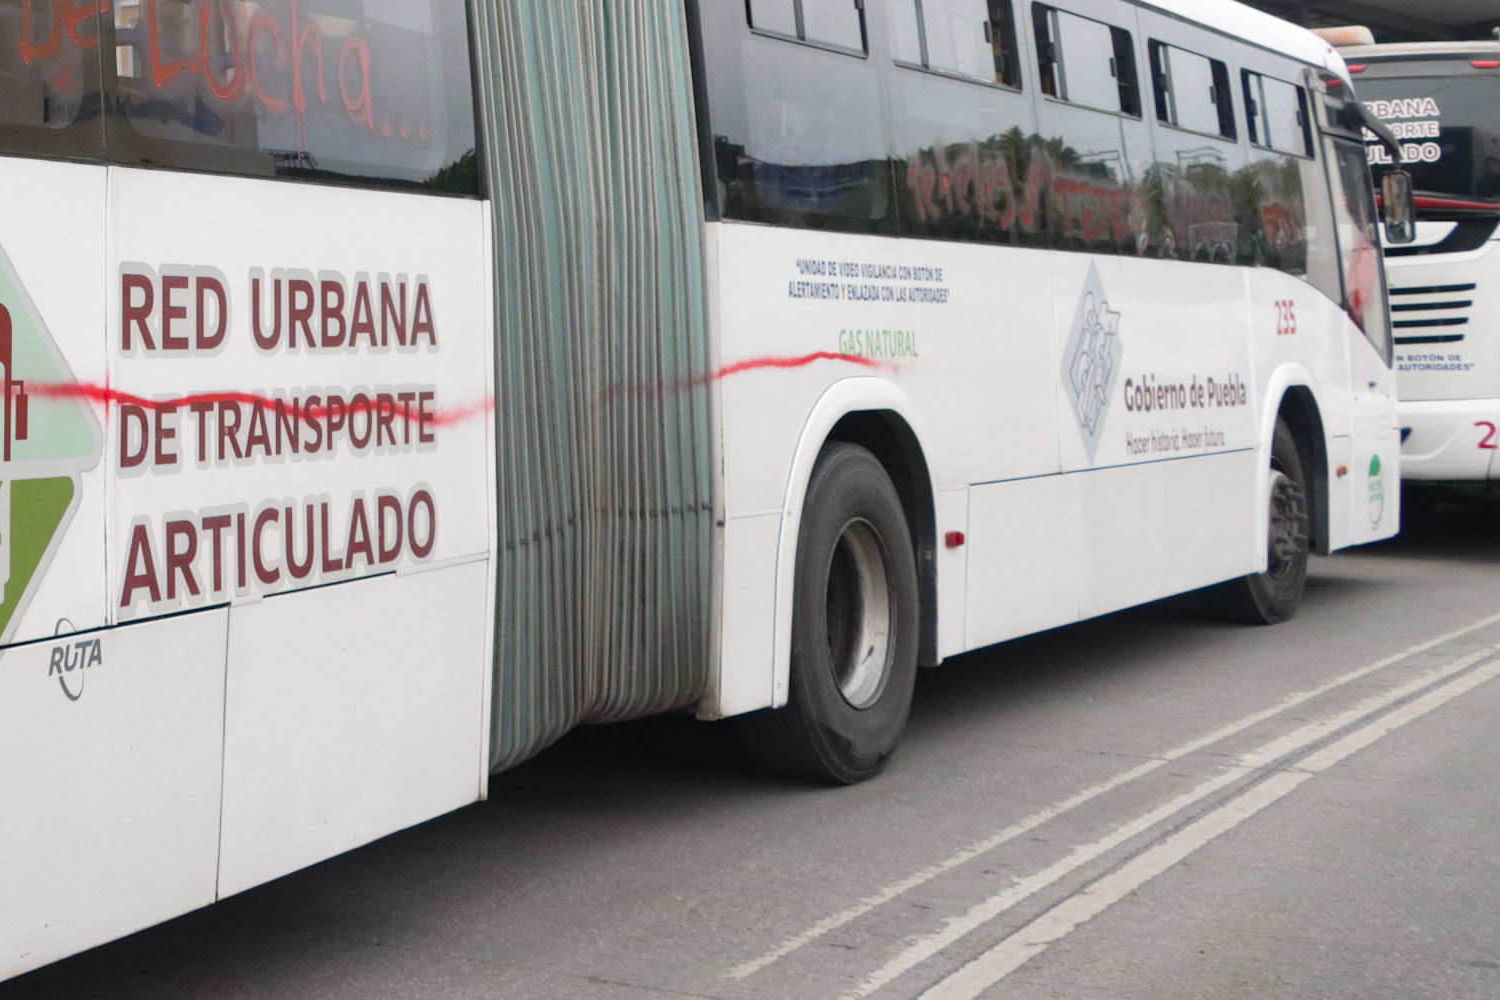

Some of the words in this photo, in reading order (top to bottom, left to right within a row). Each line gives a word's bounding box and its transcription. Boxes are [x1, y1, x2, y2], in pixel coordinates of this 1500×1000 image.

[828, 261, 837, 276] DE
[839, 262, 859, 277] VIDEO
[861, 263, 897, 279] VIGILANCIA
[899, 266, 912, 280] CON
[935, 268, 943, 282] DE
[788, 281, 840, 300] ALERTAMIENTO
[841, 283, 846, 300] Y
[847, 284, 881, 302] ENLAZADA
[882, 285, 894, 302] CON
[896, 286, 906, 302] LAS
[121, 273, 228, 351] RED
[251, 277, 437, 351] URBANA
[838, 329, 863, 357] GAS
[865, 330, 919, 357] NATURAL
[1448, 353, 1462, 362] DE
[1125, 373, 1186, 412] Gobierno
[1190, 374, 1205, 408] de
[1208, 373, 1247, 408] Puebla
[119, 401, 178, 468] DE
[189, 390, 436, 463] TRANSPORTE
[120, 489, 437, 608] ARTICULADO
[47, 638, 103, 677] RUTA
